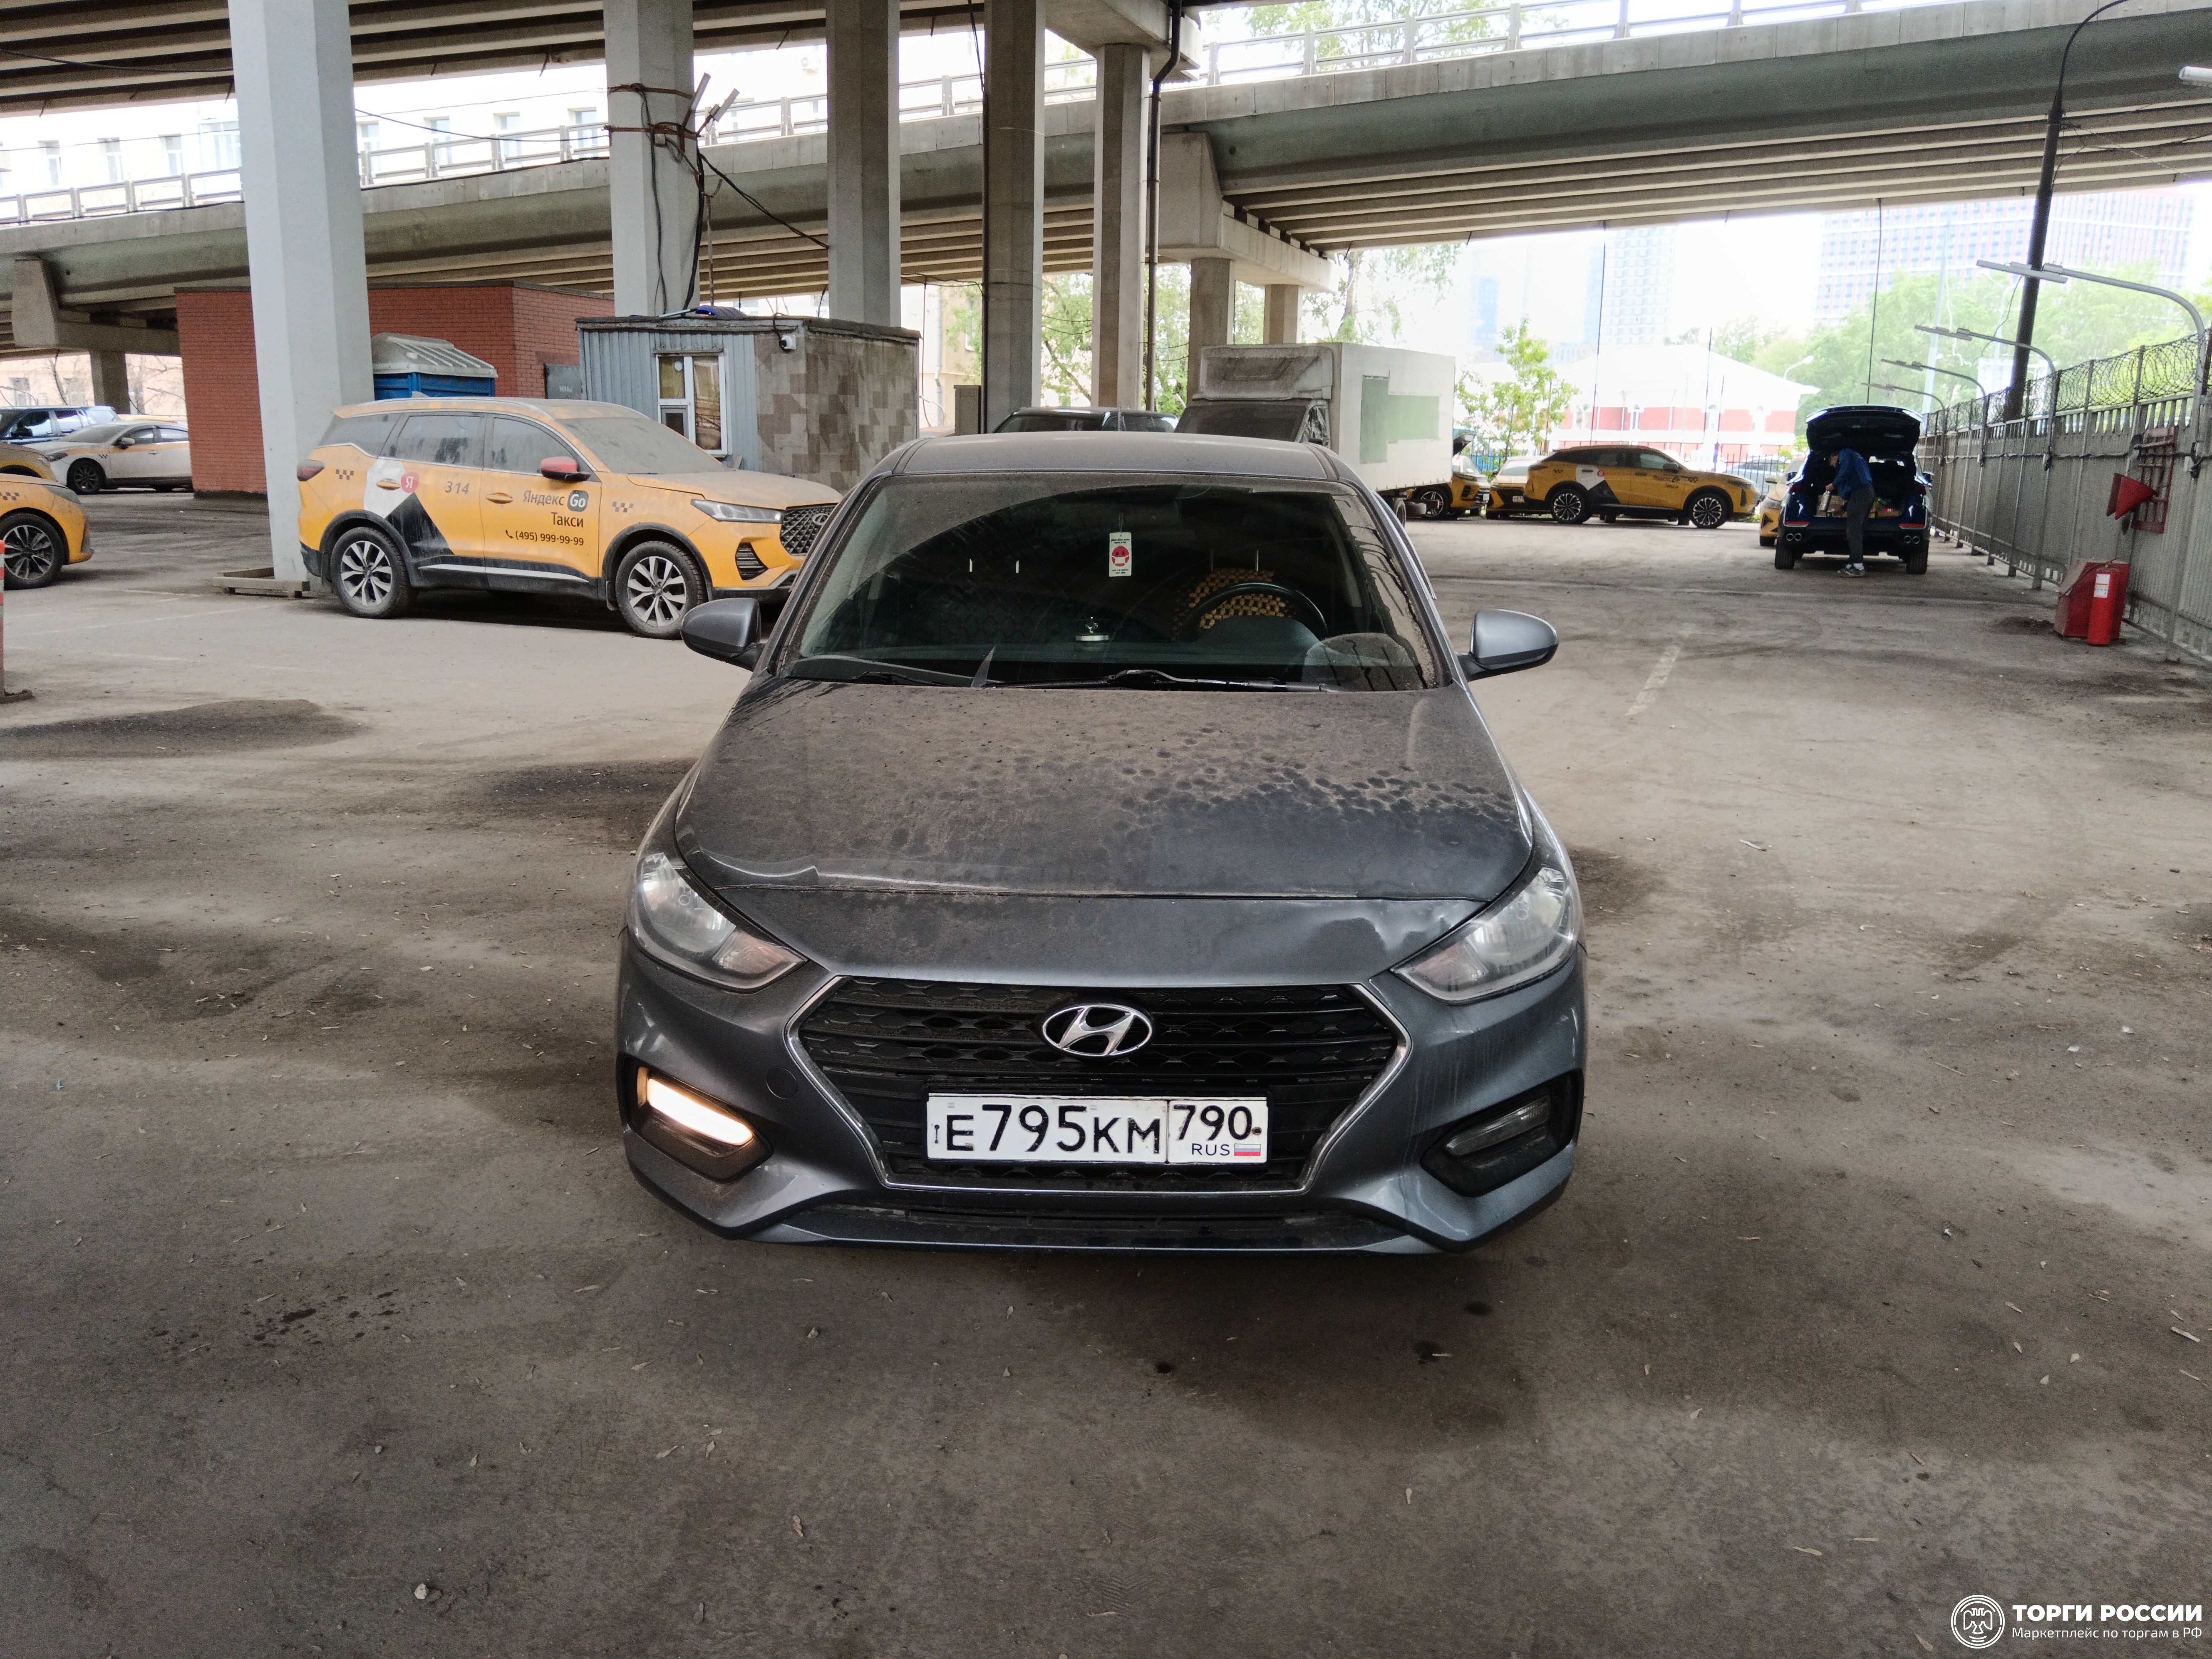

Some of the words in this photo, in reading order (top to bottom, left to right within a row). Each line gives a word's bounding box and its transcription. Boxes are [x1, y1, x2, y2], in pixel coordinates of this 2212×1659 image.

[445, 481, 470, 495] 314
[522, 490, 565, 506] Яндекс
[570, 494, 586, 508] Go
[551, 512, 584, 527] Такси
[515, 530, 537, 542] (495)
[540, 533, 584, 546] 999-99-99
[1172, 1104, 1253, 1141] 790
[1191, 1143, 1231, 1156] RUS
